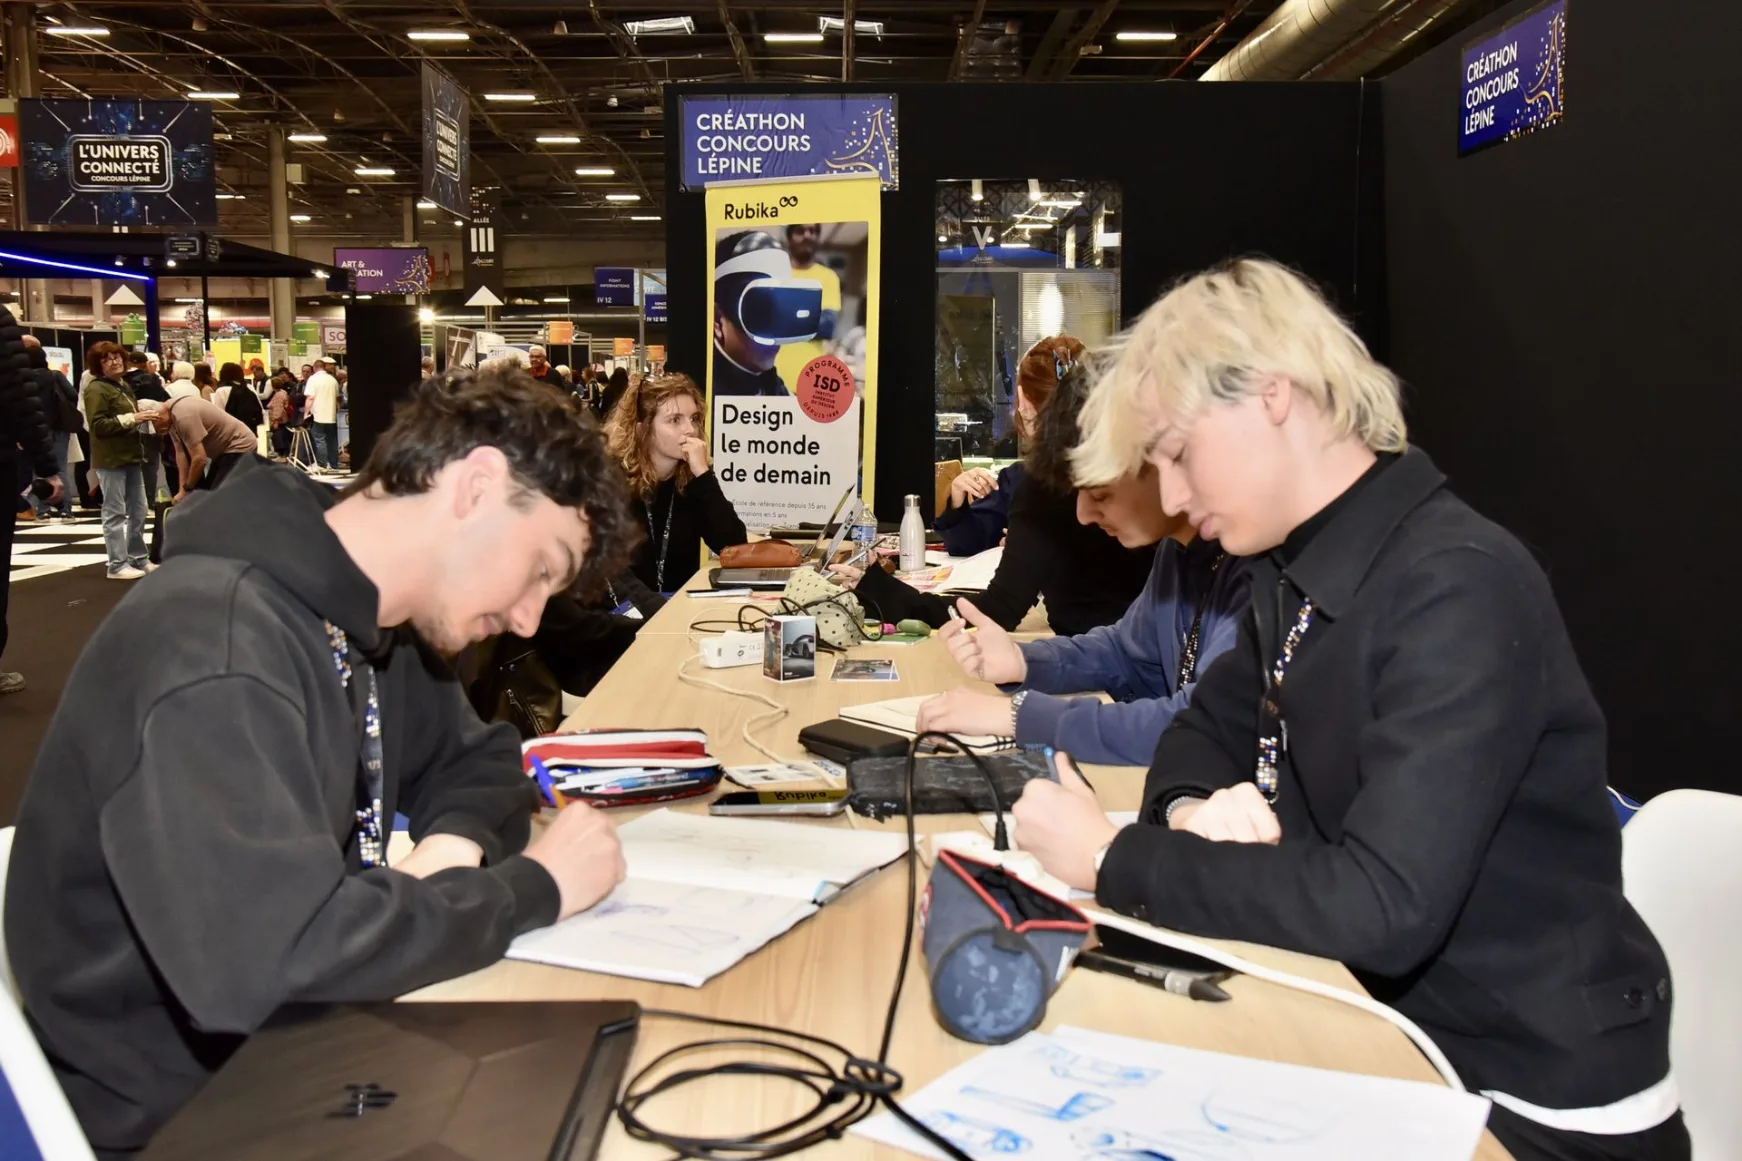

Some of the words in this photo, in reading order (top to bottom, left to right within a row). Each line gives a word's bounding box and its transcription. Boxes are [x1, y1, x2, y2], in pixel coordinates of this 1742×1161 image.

[1467, 41, 1517, 83] CRÉATHON
[1466, 68, 1519, 109] CONCOURS
[697, 109, 804, 131] CRÉATHON
[1465, 105, 1495, 135] LÉPINE
[79, 145, 159, 159] L'UNIVERS
[697, 135, 811, 152] CONCOURS
[80, 159, 160, 174] CONNECTÉ
[698, 153, 762, 174] LÉPINE
[129, 174, 151, 182] LÉPINE
[724, 203, 779, 220] Rubika
[341, 261, 357, 269] ART
[805, 360, 850, 387] PROGRAMME
[813, 374, 840, 392] ISD
[722, 404, 793, 431] Design
[721, 433, 741, 453] le
[748, 434, 820, 455] monde
[721, 462, 747, 482] de
[754, 463, 830, 485] demain
[787, 502, 806, 510] depuis
